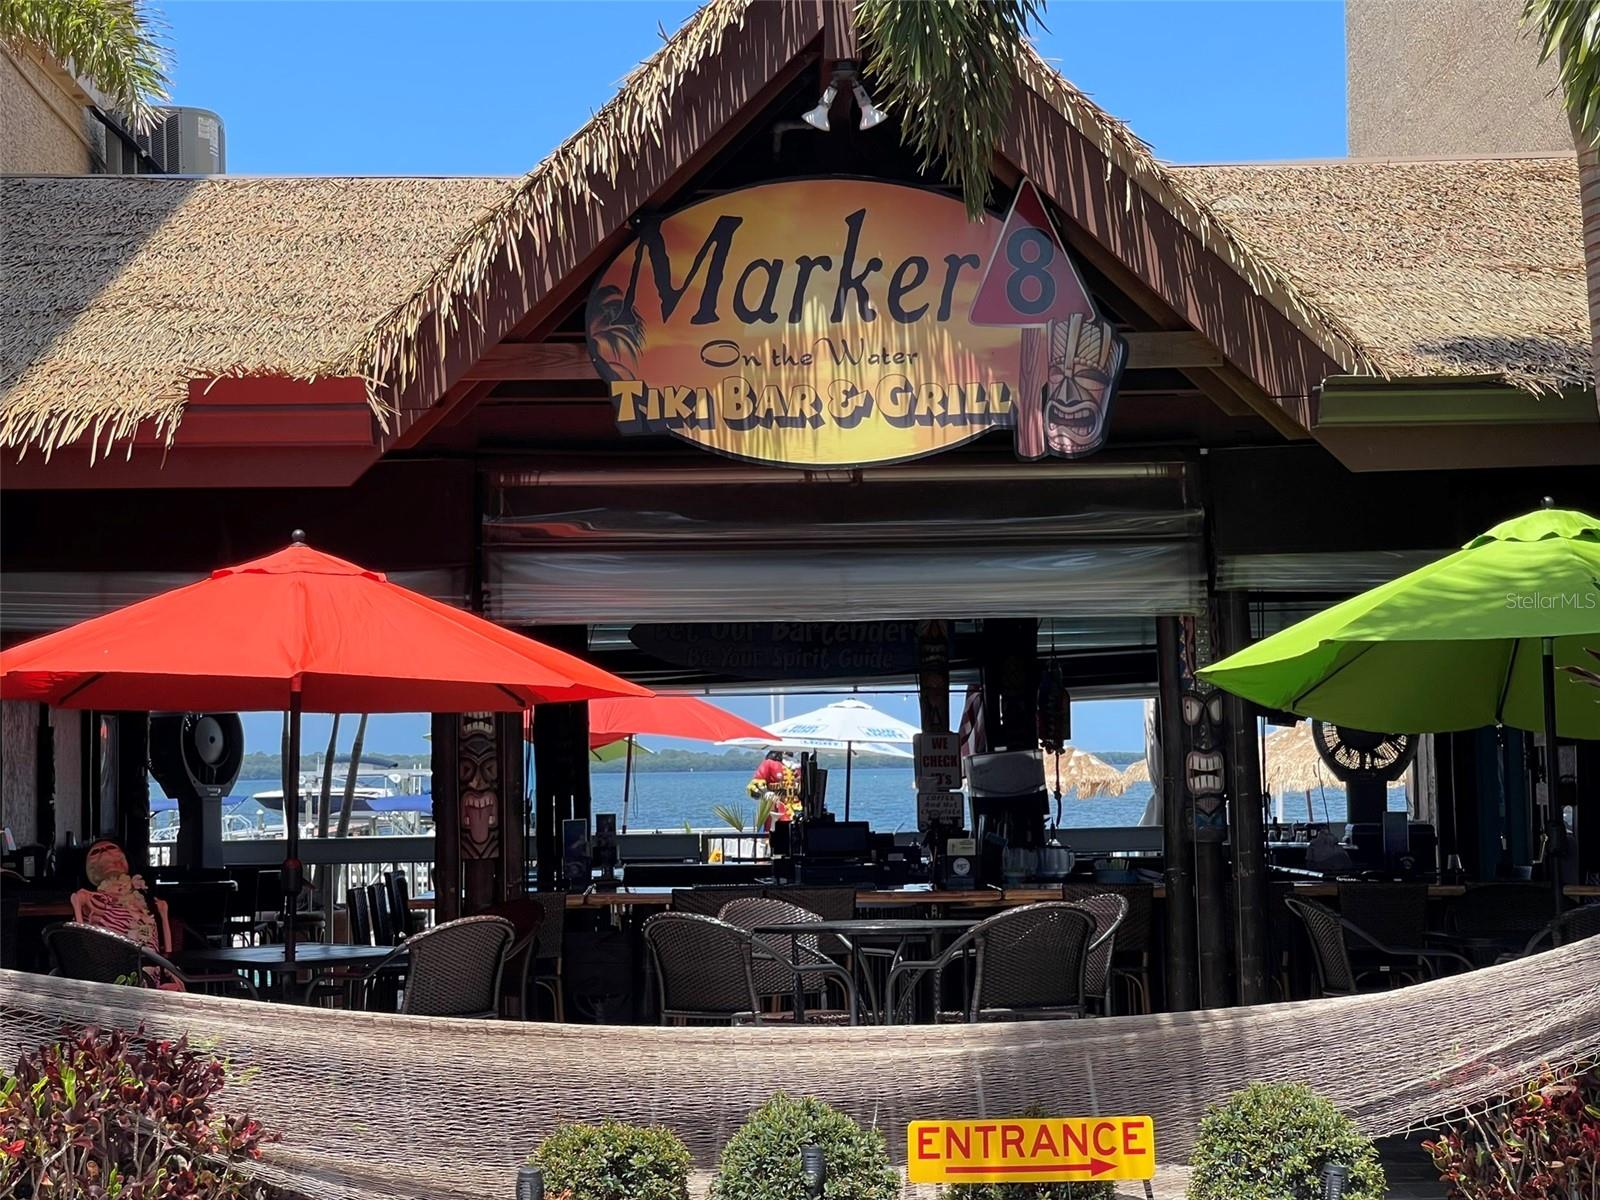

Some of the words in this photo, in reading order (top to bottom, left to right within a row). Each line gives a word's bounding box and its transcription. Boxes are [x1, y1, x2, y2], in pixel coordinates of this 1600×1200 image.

[611, 208, 981, 325] Marker
[1006, 227, 1056, 315] 8
[700, 339, 762, 368] On
[772, 343, 813, 367] the
[814, 337, 918, 366] Water
[610, 379, 714, 430] TIKI
[722, 375, 824, 430] BAR
[827, 378, 873, 429] &
[875, 373, 1017, 429] GRILL
[721, 647, 763, 668] Your
[773, 647, 832, 672] Spirit
[838, 647, 895, 669] Guide
[931, 737, 948, 749] WE
[922, 754, 958, 768] CHECK
[930, 772, 953, 786] D's
[918, 1121, 1147, 1160] ENTRANCE
